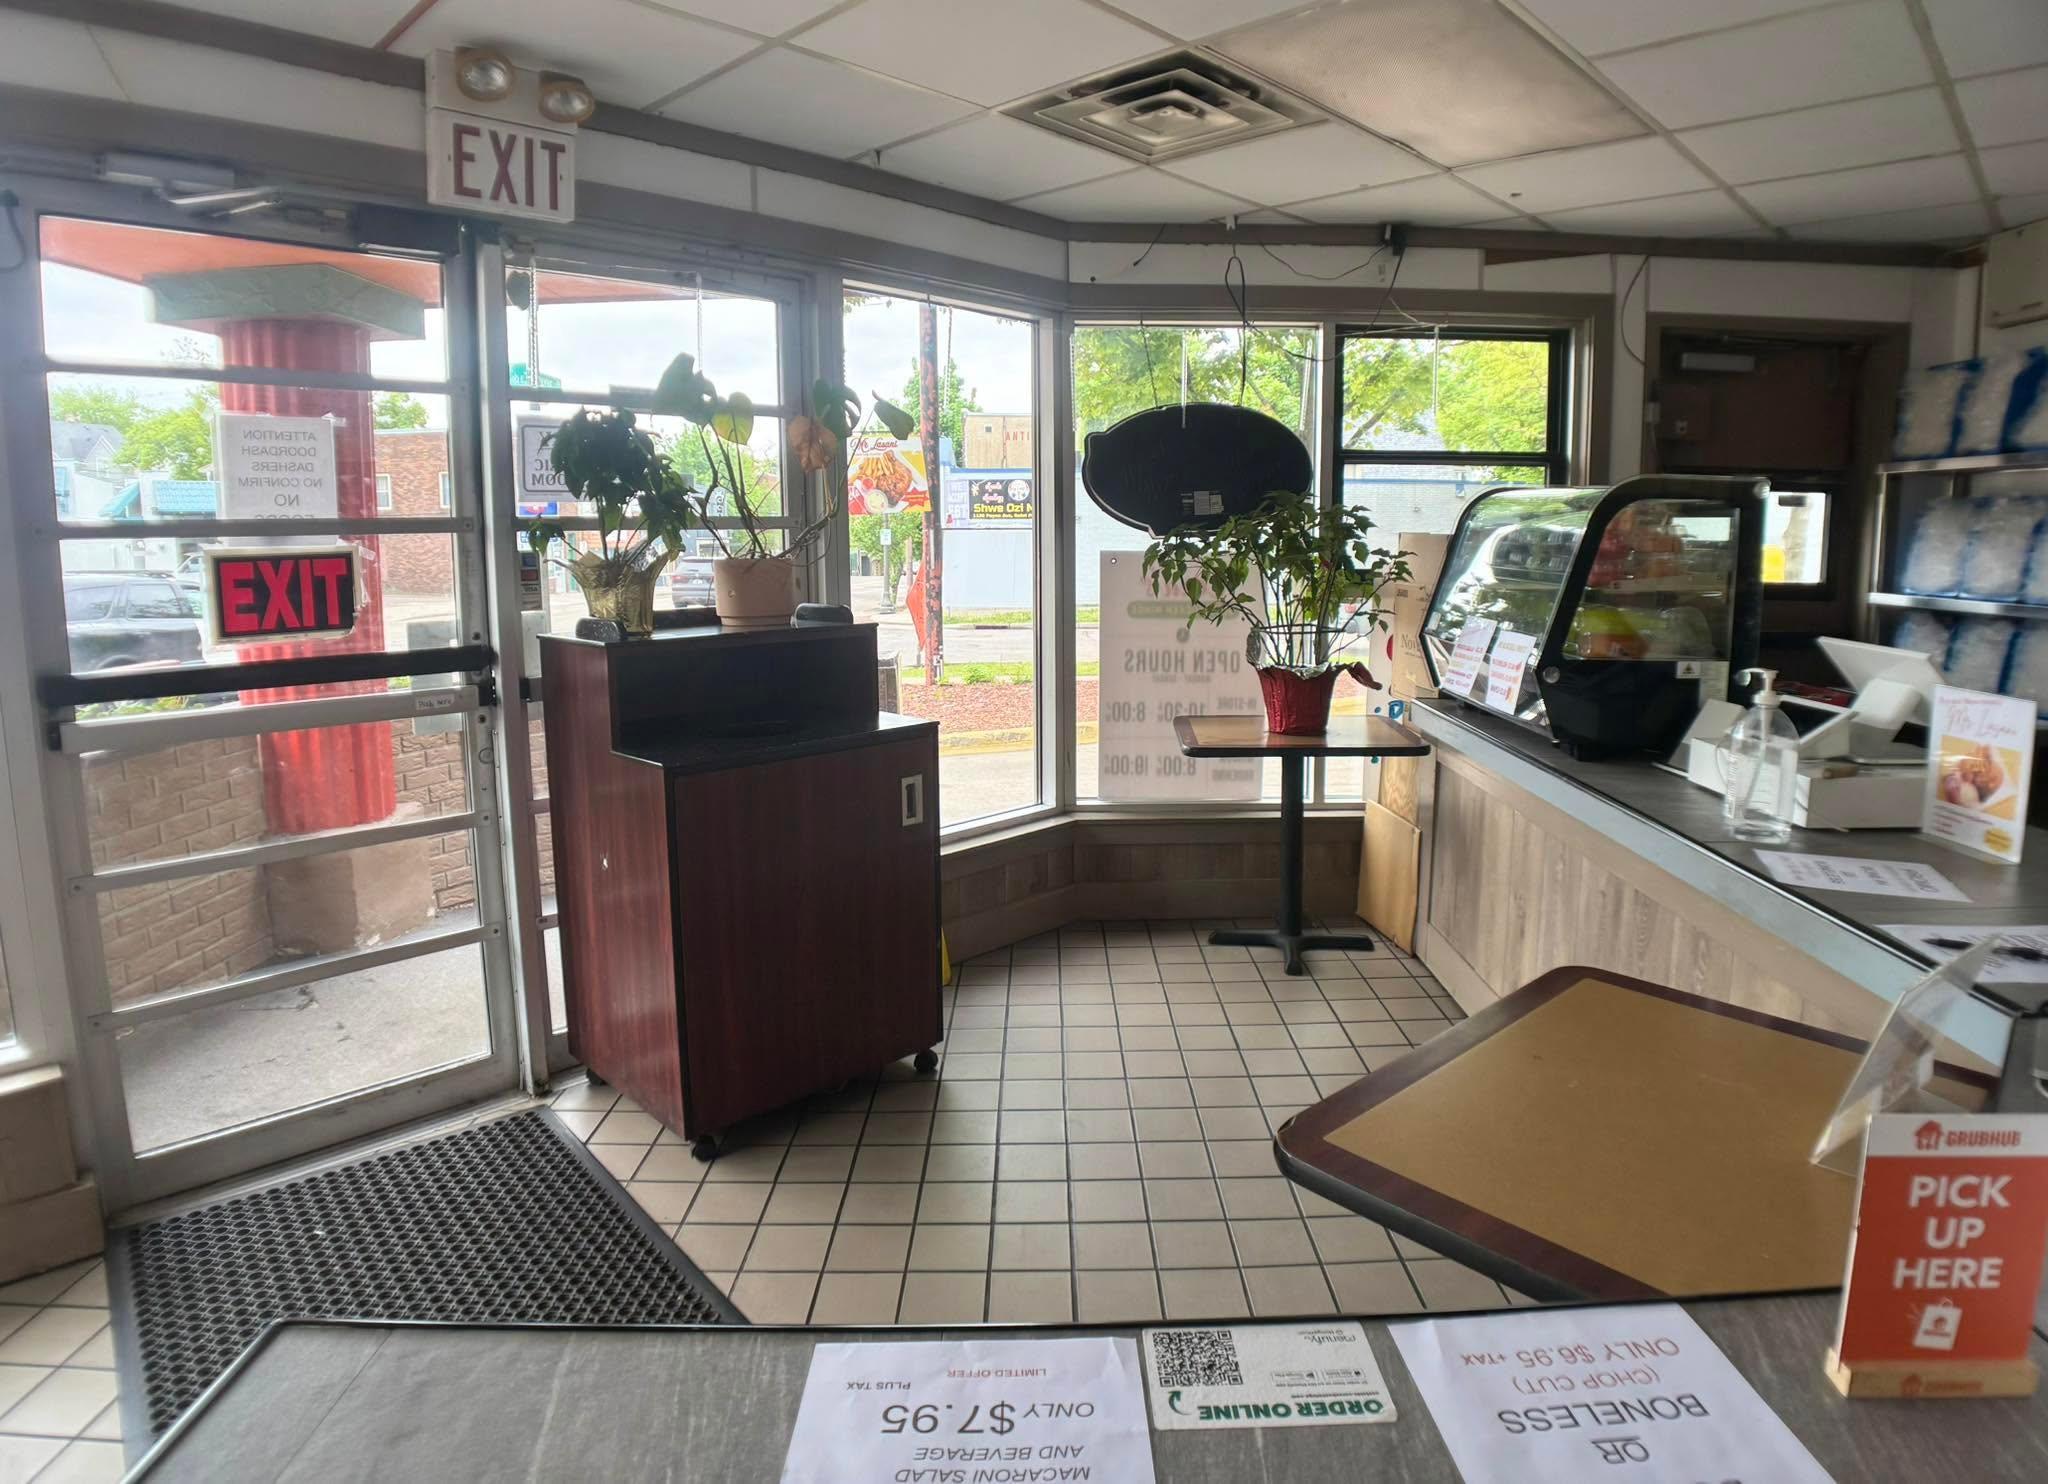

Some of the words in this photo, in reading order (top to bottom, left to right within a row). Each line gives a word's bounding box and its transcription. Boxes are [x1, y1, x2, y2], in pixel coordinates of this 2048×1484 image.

[453, 123, 566, 211] EXIT
[973, 502, 1004, 513] Shwe
[219, 558, 348, 633] EXIT
[1946, 1131, 2022, 1148] GRUBHUB
[1908, 1175, 2013, 1209] PICK
[1924, 1217, 1986, 1249] UP
[1893, 1257, 2004, 1290] HERE
[1516, 1344, 1596, 1369] $6.95
[1605, 1336, 1681, 1361] ONLY
[1460, 1352, 1507, 1367] +TAX
[946, 1368, 991, 1377] OFFER
[995, 1368, 1047, 1378] LIMITED
[1583, 1365, 1661, 1390] (CHOP
[847, 1381, 872, 1391] TAX
[876, 1381, 911, 1390] PLUS
[1512, 1375, 1576, 1395] CUT)
[1023, 1402, 1095, 1419] ONLY
[1198, 1402, 1292, 1421] ONLINE
[1298, 1399, 1384, 1417] ORDER
[1498, 1393, 1711, 1434] BONELESS
[881, 1400, 1016, 1436] $7.95
[913, 1446, 1032, 1461] BEVERAGE
[1039, 1444, 1085, 1459] AND
[1592, 1436, 1650, 1465] OR
[894, 1467, 968, 1484] SALAD
[973, 1466, 1091, 1482] MACARONI
